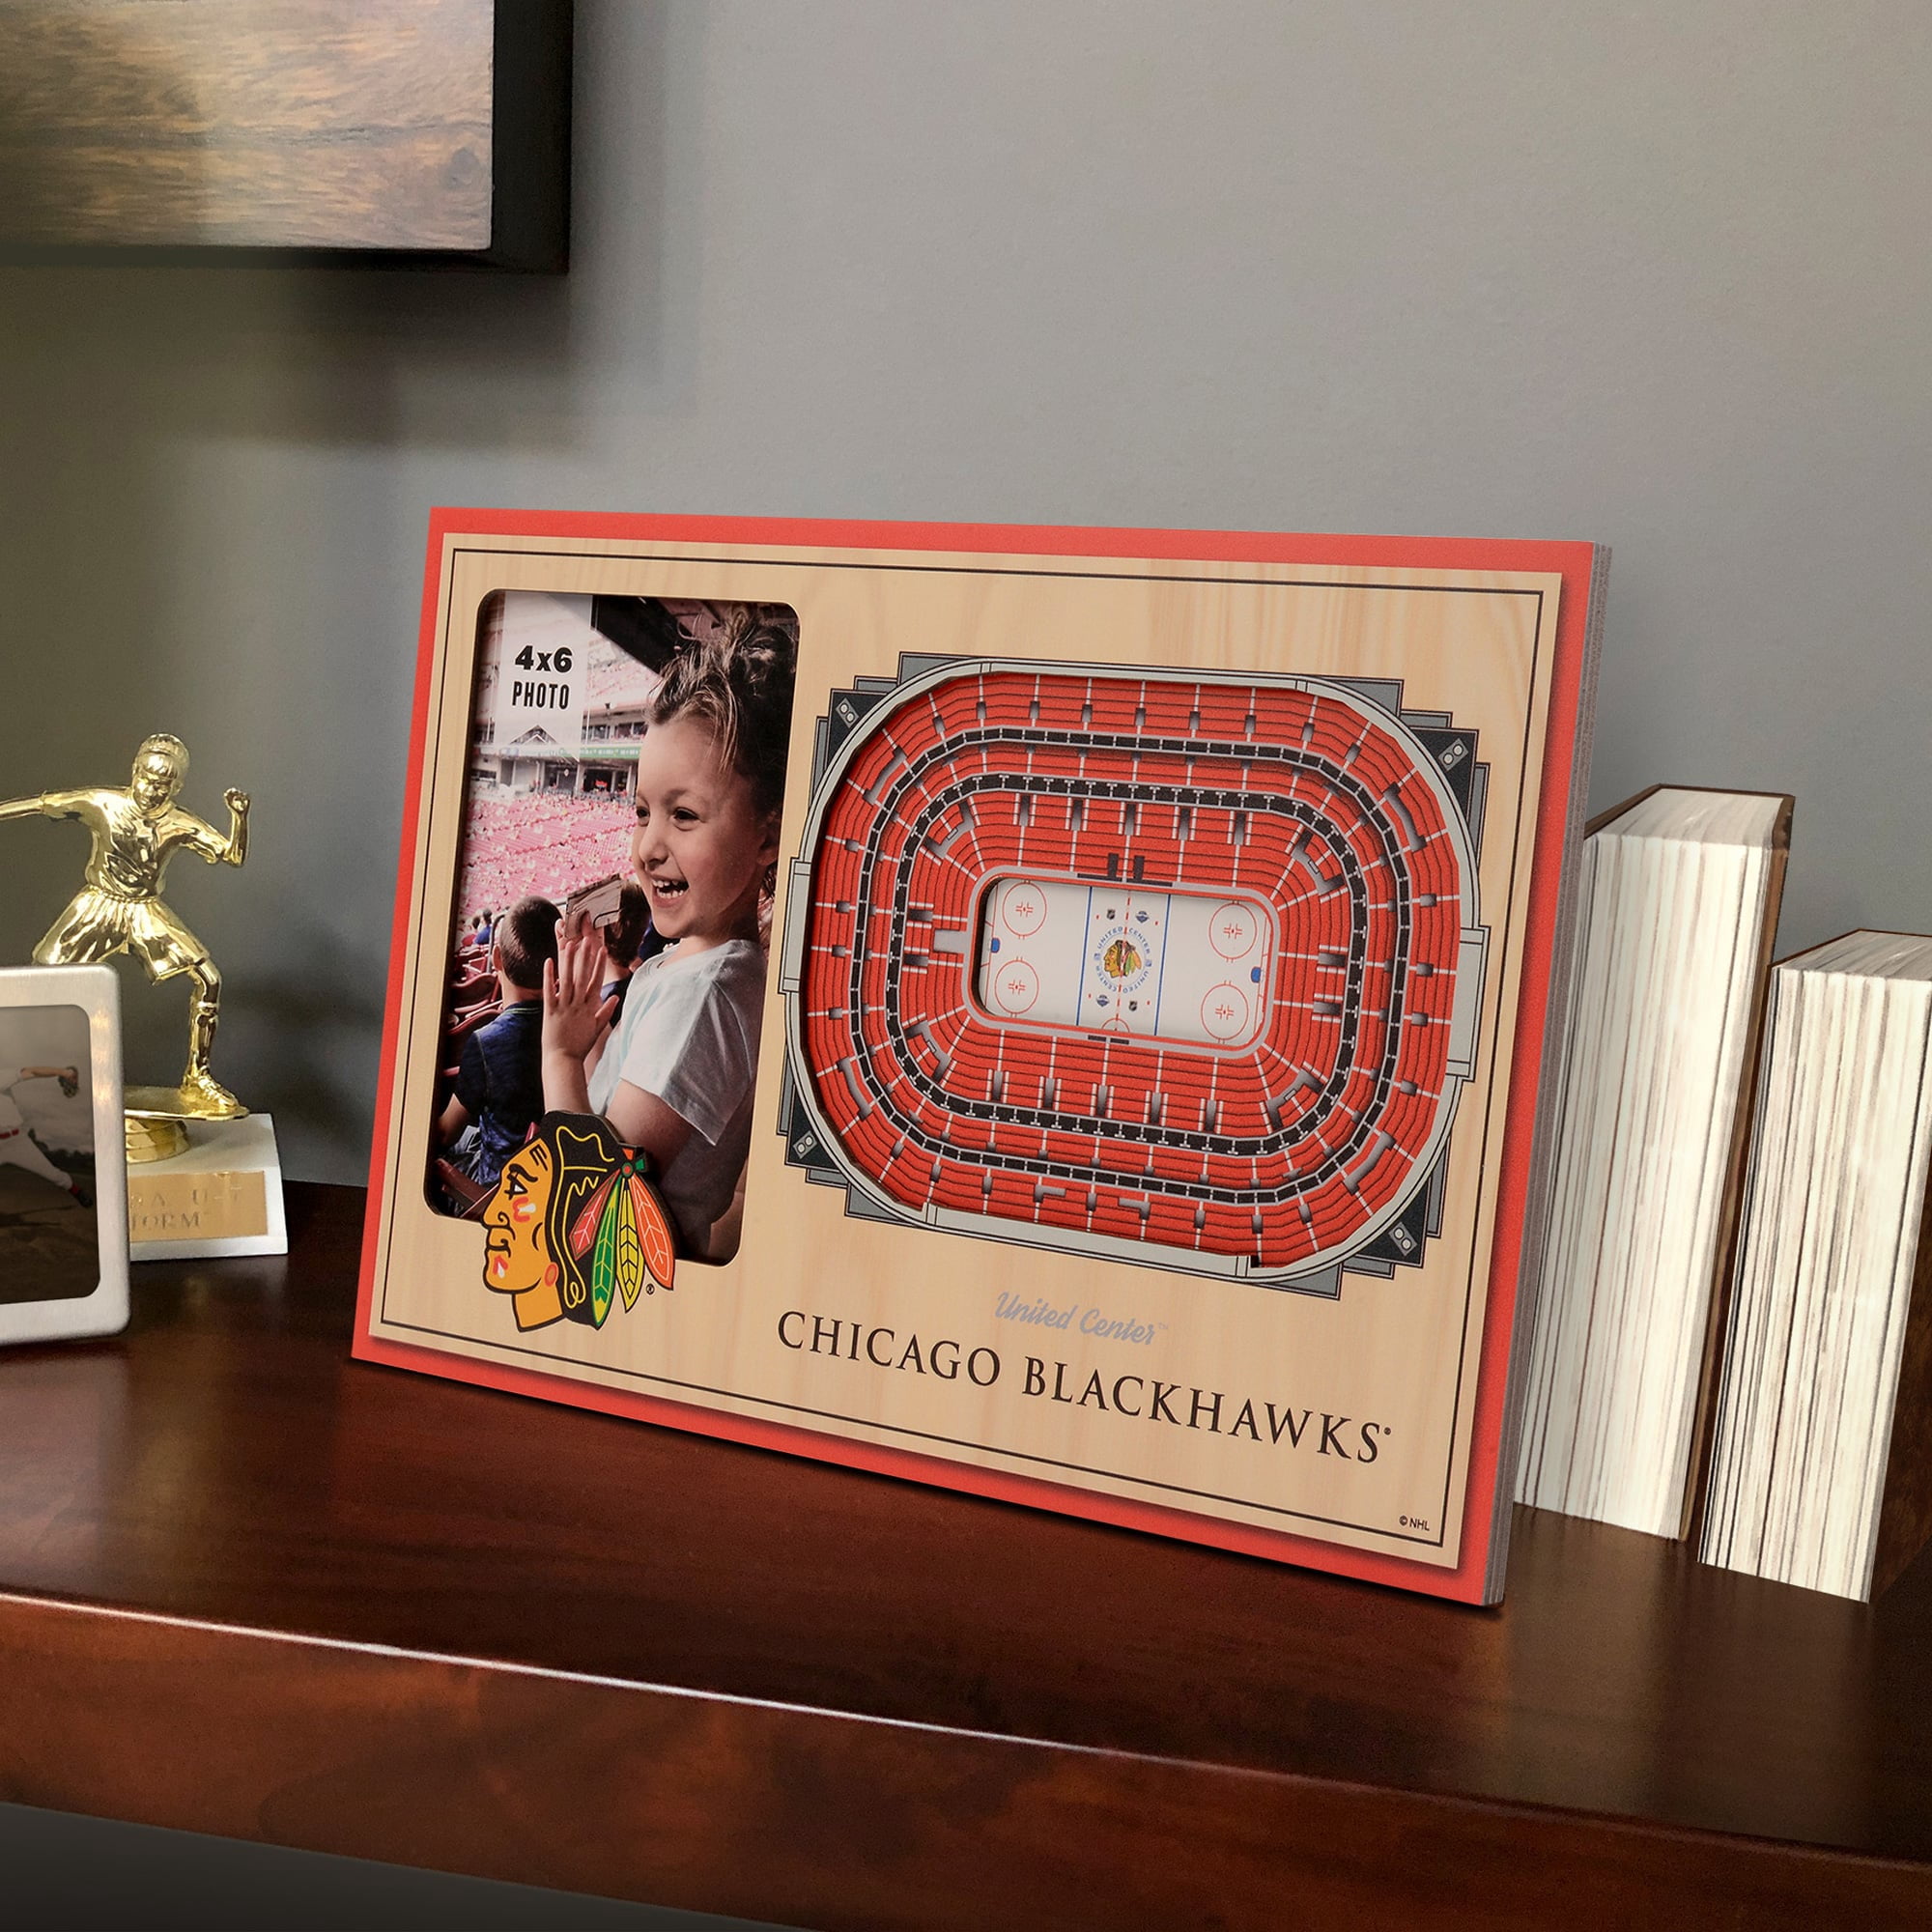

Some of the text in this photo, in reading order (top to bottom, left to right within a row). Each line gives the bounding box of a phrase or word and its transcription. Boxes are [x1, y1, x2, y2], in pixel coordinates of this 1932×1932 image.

[515, 645, 573, 673] 4x6
[512, 681, 569, 710] PHOTO
[995, 1292, 1078, 1329] United
[777, 1311, 1001, 1387] CHICAGO
